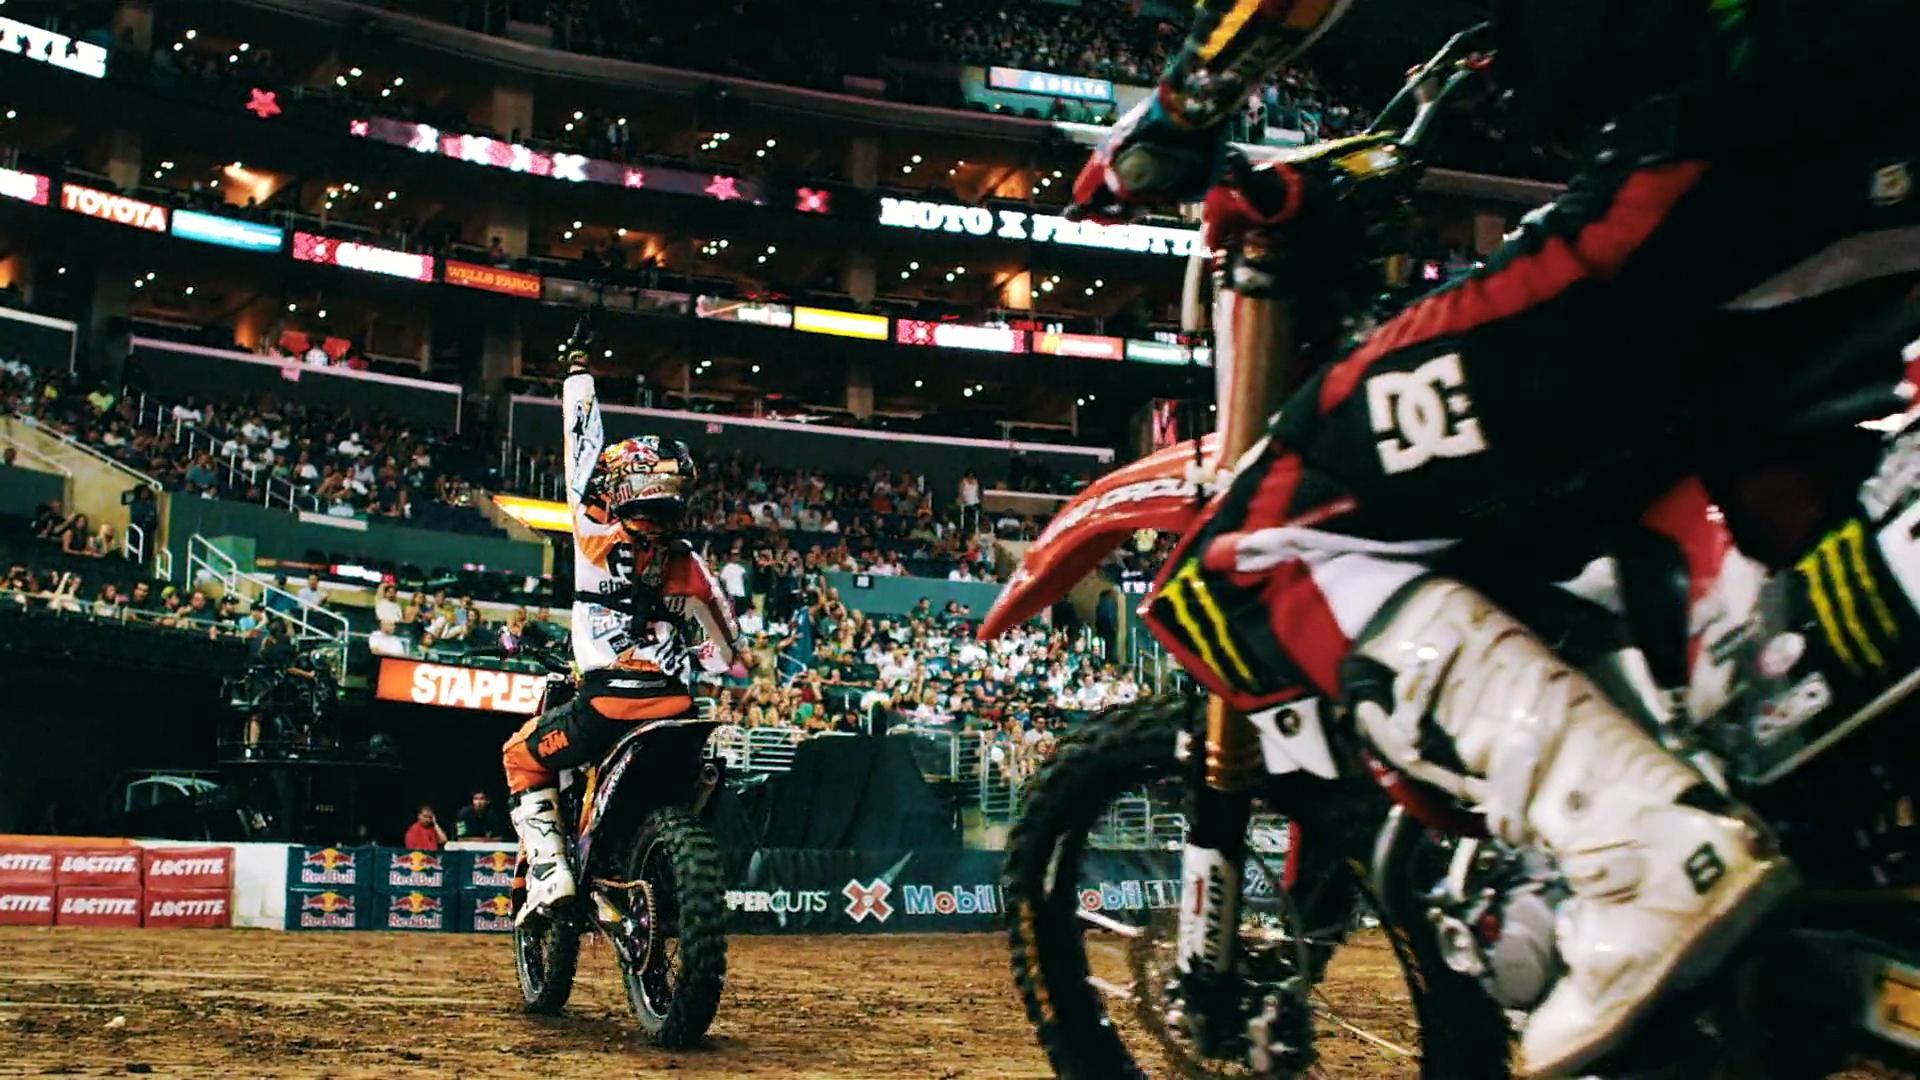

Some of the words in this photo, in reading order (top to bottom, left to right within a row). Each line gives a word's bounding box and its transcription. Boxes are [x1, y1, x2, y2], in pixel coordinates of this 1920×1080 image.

[63, 184, 167, 232] TOYOTA
[879, 198, 993, 236] MOTO
[997, 210, 1027, 240] X
[447, 266, 495, 285] WELLS
[496, 274, 540, 292] FARGO
[411, 663, 547, 714] STAPLES
[302, 870, 328, 884] Red
[329, 869, 355, 885] Bull
[390, 871, 416, 886] Red
[416, 871, 442, 887] Bull
[904, 884, 997, 914] Mobil
[1079, 880, 1143, 911] obil
[301, 913, 328, 927] Red
[328, 912, 355, 928] Bull
[389, 913, 415, 928] Red
[415, 913, 442, 929] Bull
